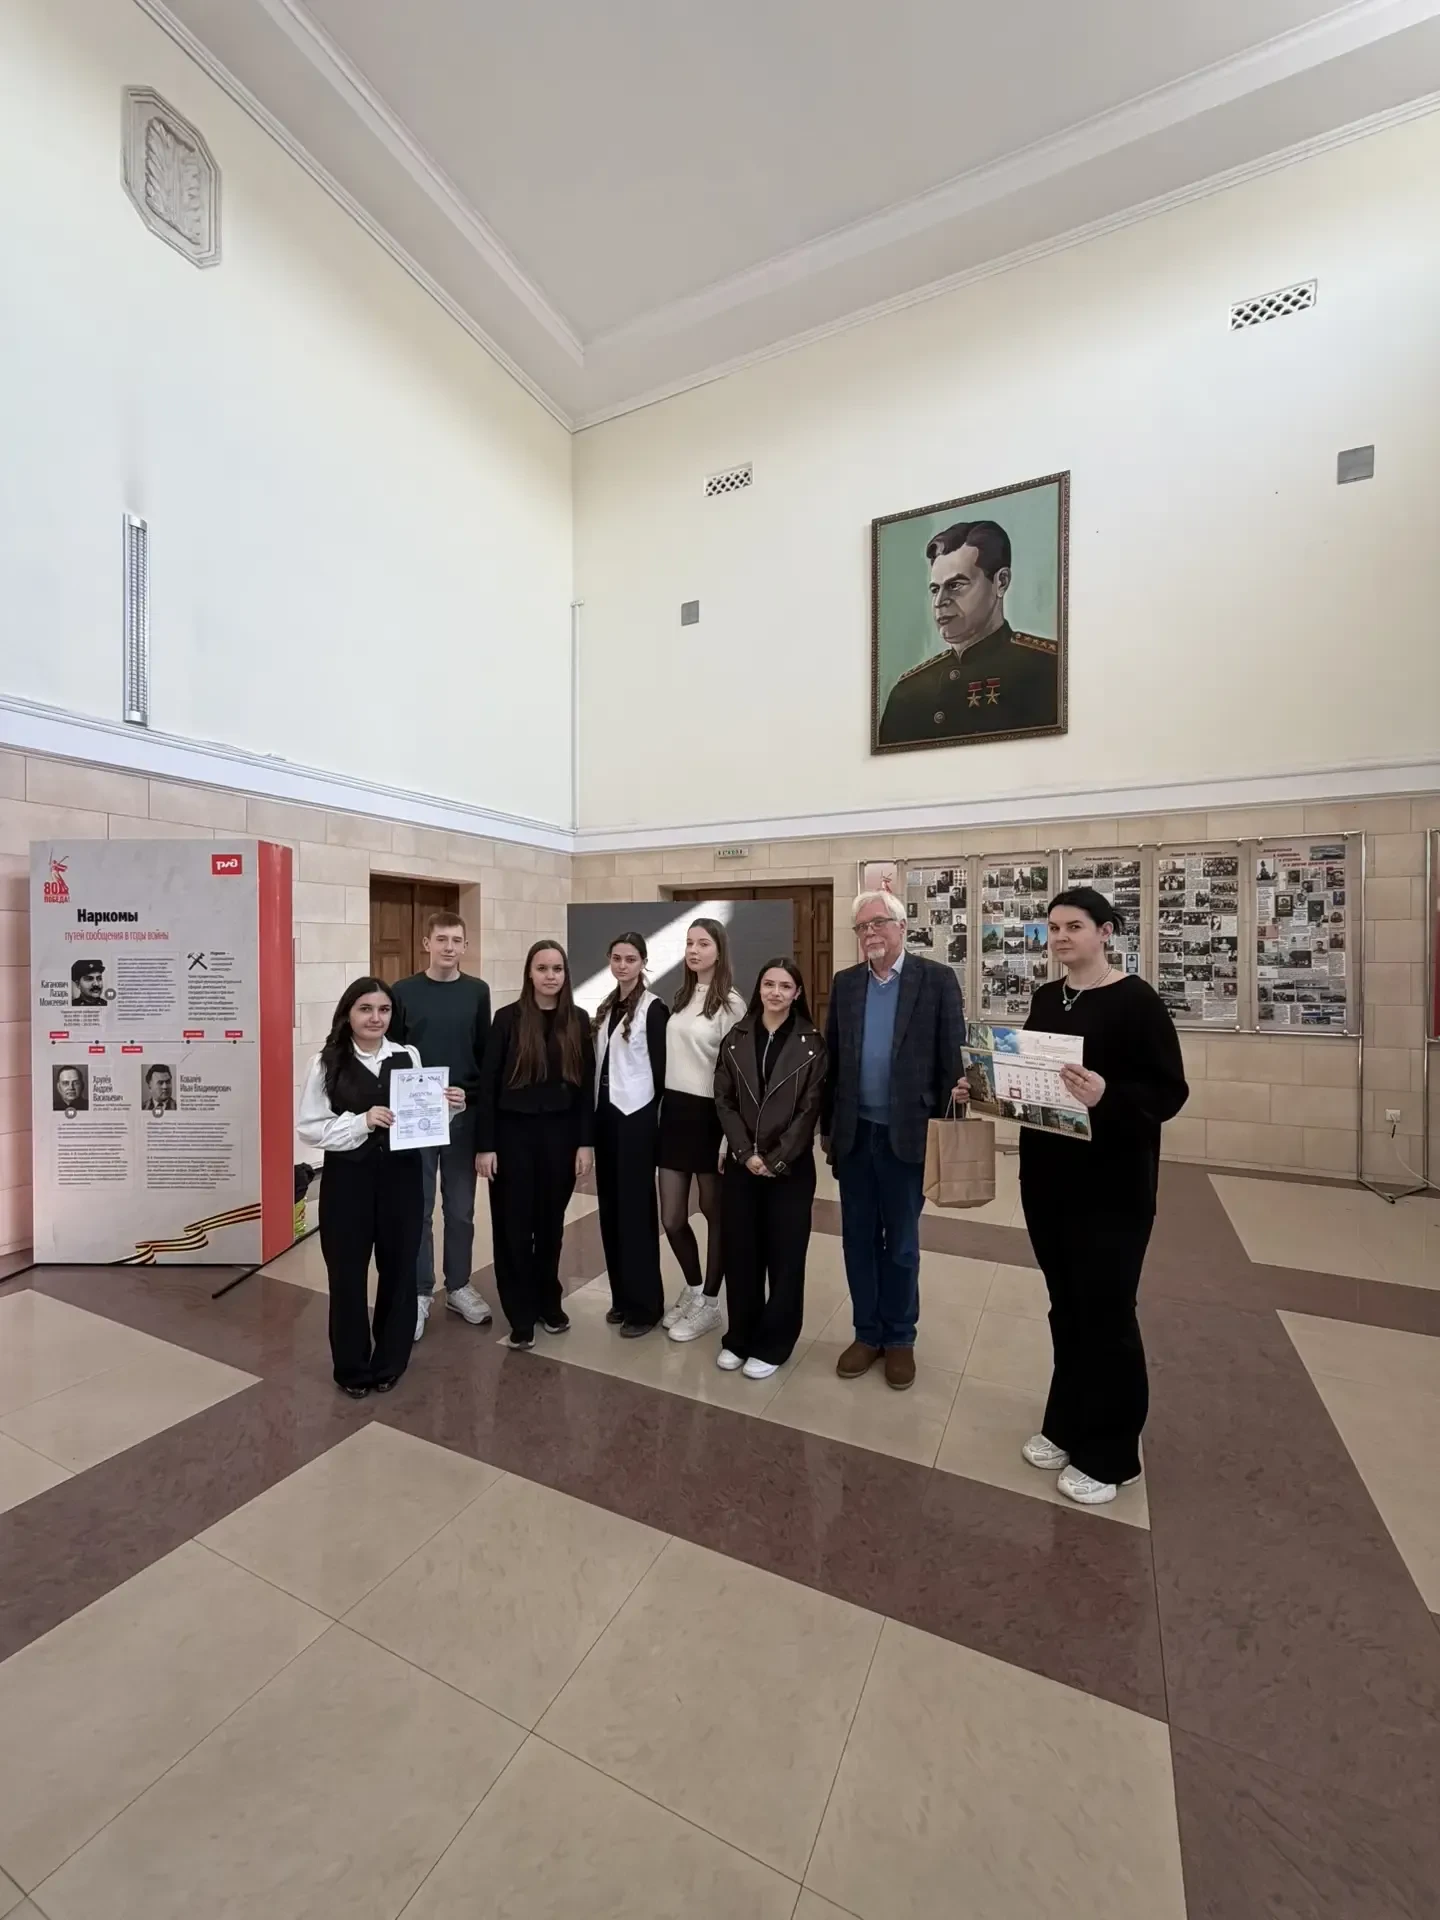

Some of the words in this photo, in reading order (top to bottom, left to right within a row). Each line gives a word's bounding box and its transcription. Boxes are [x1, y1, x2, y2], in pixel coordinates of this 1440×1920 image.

[43, 881, 58, 895] 80
[77, 908, 138, 926] Наркомы
[64, 929, 85, 943] путей
[86, 928, 124, 942] сообщения
[125, 932, 129, 940] в
[130, 931, 146, 942] годы
